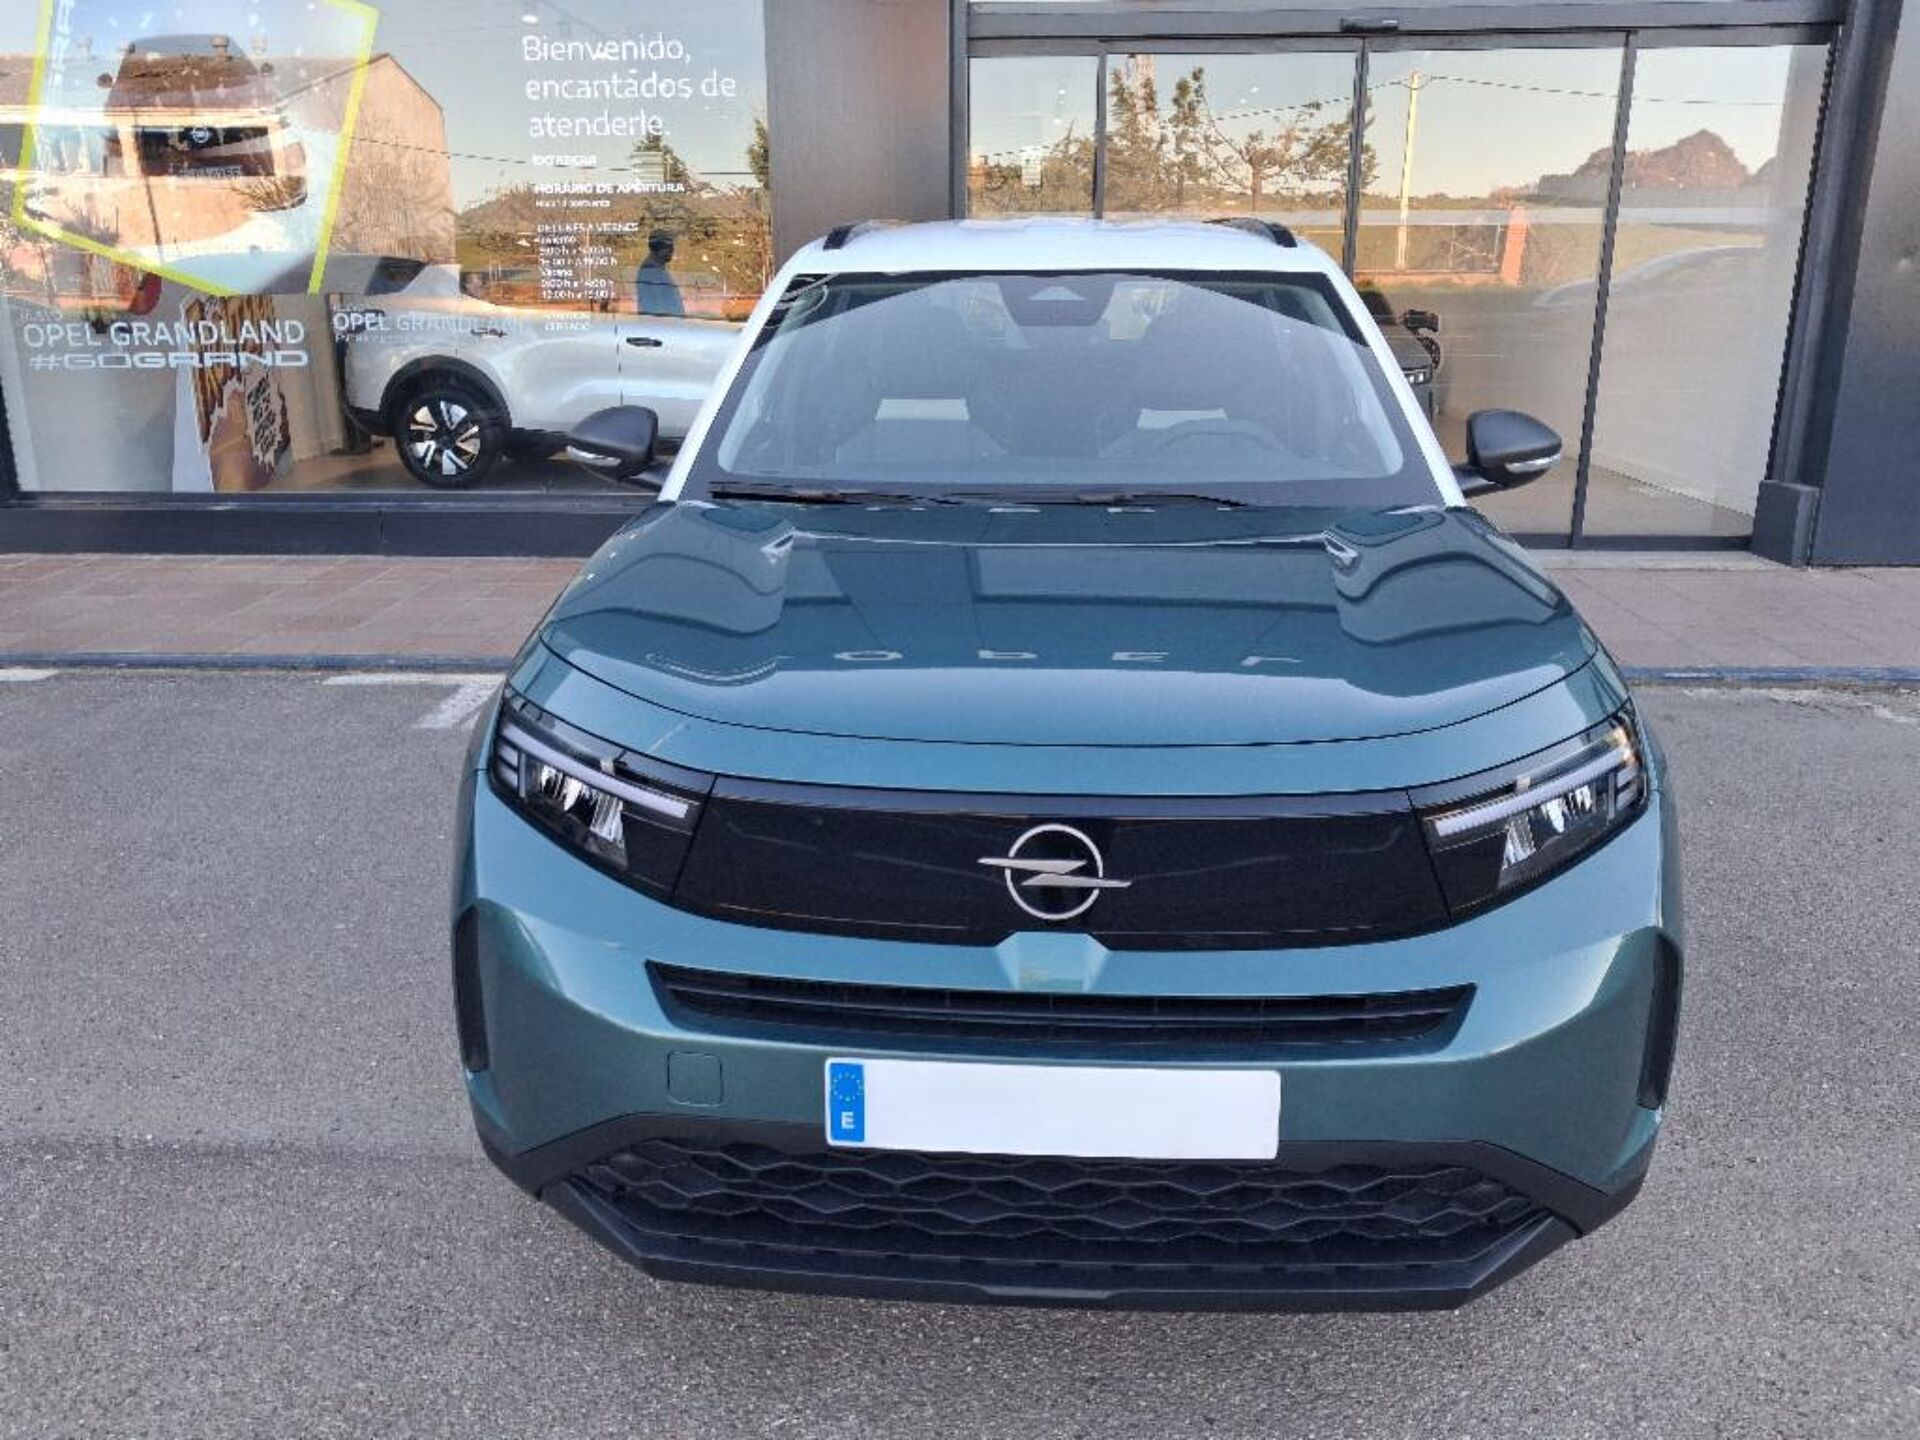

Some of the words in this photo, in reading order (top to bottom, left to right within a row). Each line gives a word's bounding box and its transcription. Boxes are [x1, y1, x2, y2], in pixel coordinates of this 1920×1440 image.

[522, 33, 691, 63] Bienvenido,
[525, 69, 694, 100] encantados
[701, 68, 737, 98] de
[23, 320, 103, 348] OPEL
[110, 319, 306, 347] GRANDLAND
[333, 312, 391, 332] OPEL
[29, 349, 309, 370] #GOGRAND
[841, 1112, 855, 1130] E
